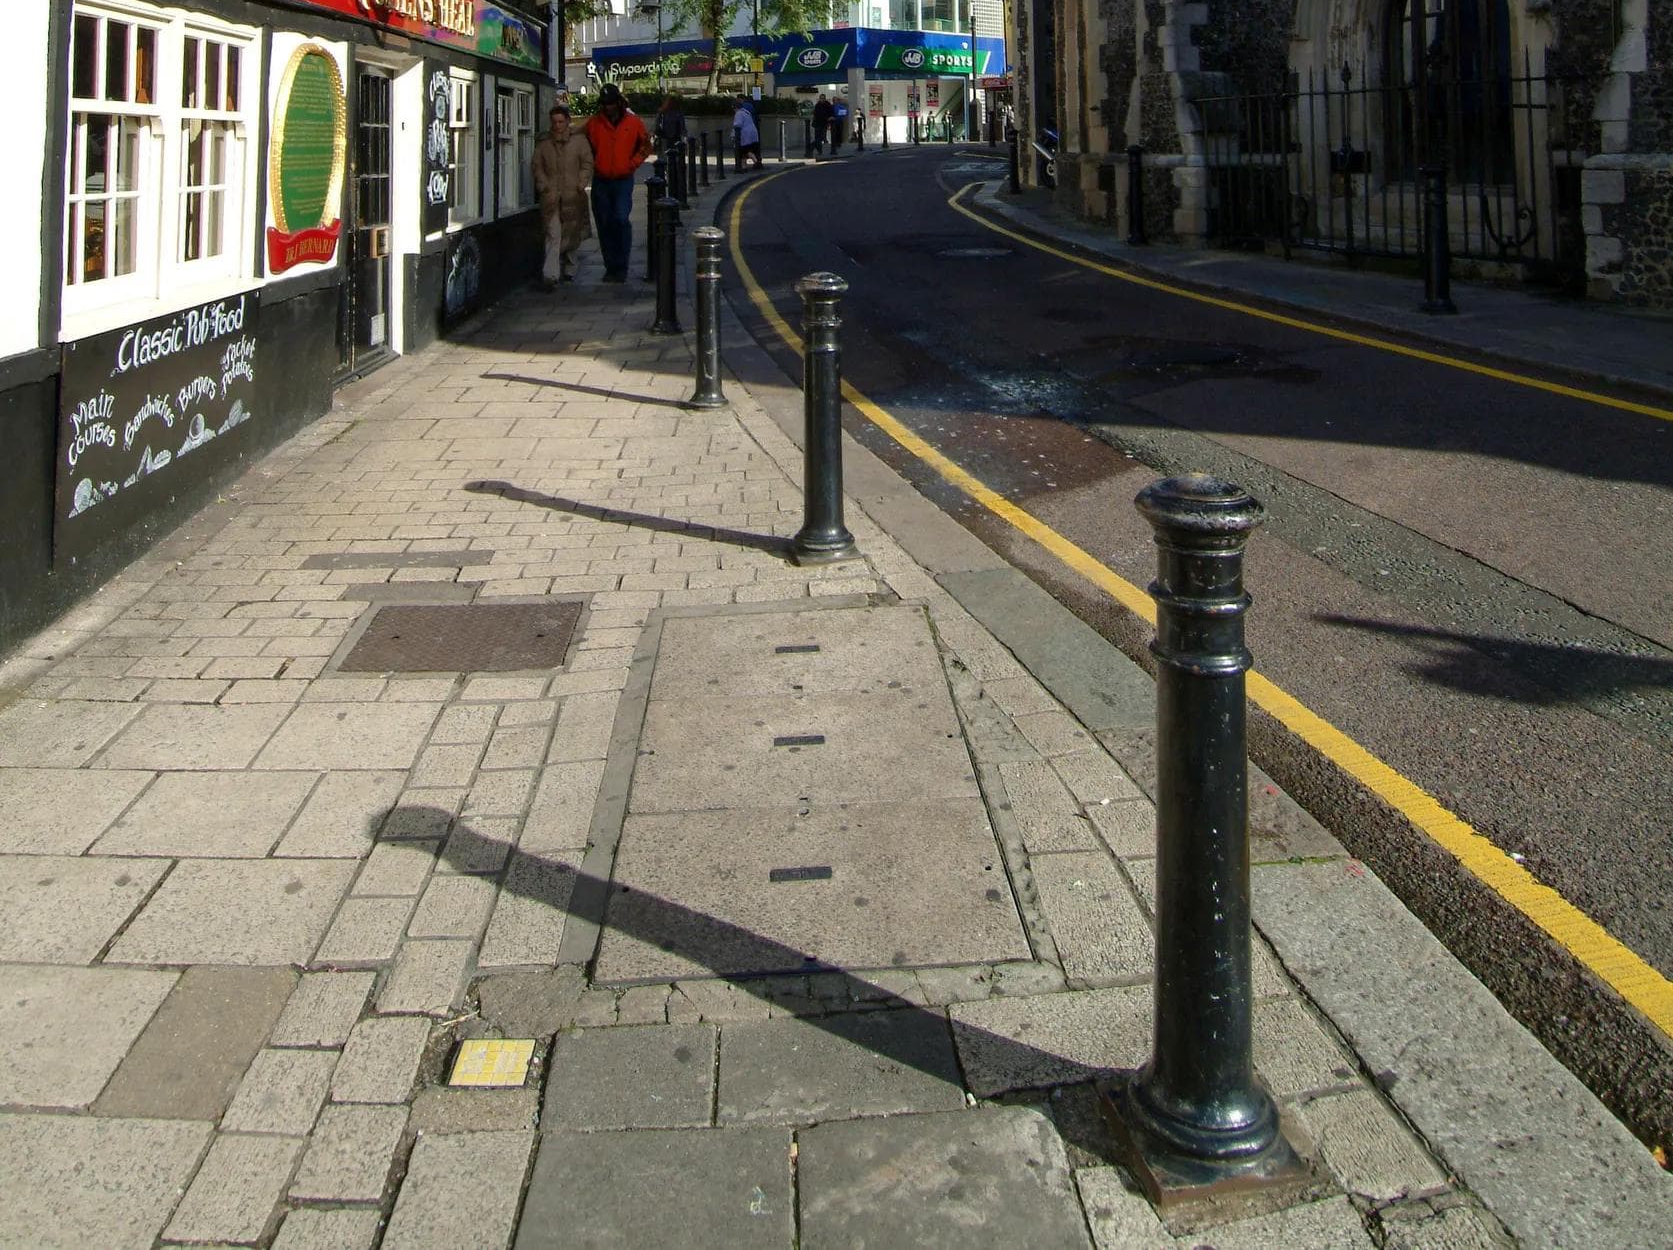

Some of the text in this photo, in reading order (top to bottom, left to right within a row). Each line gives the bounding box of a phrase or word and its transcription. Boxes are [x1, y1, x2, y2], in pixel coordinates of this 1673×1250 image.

[905, 53, 973, 67] JJB SPORTS
[114, 319, 184, 372] Classic
[185, 306, 210, 347] Pub
[70, 389, 115, 435] Main
[177, 376, 217, 414] Burgers
